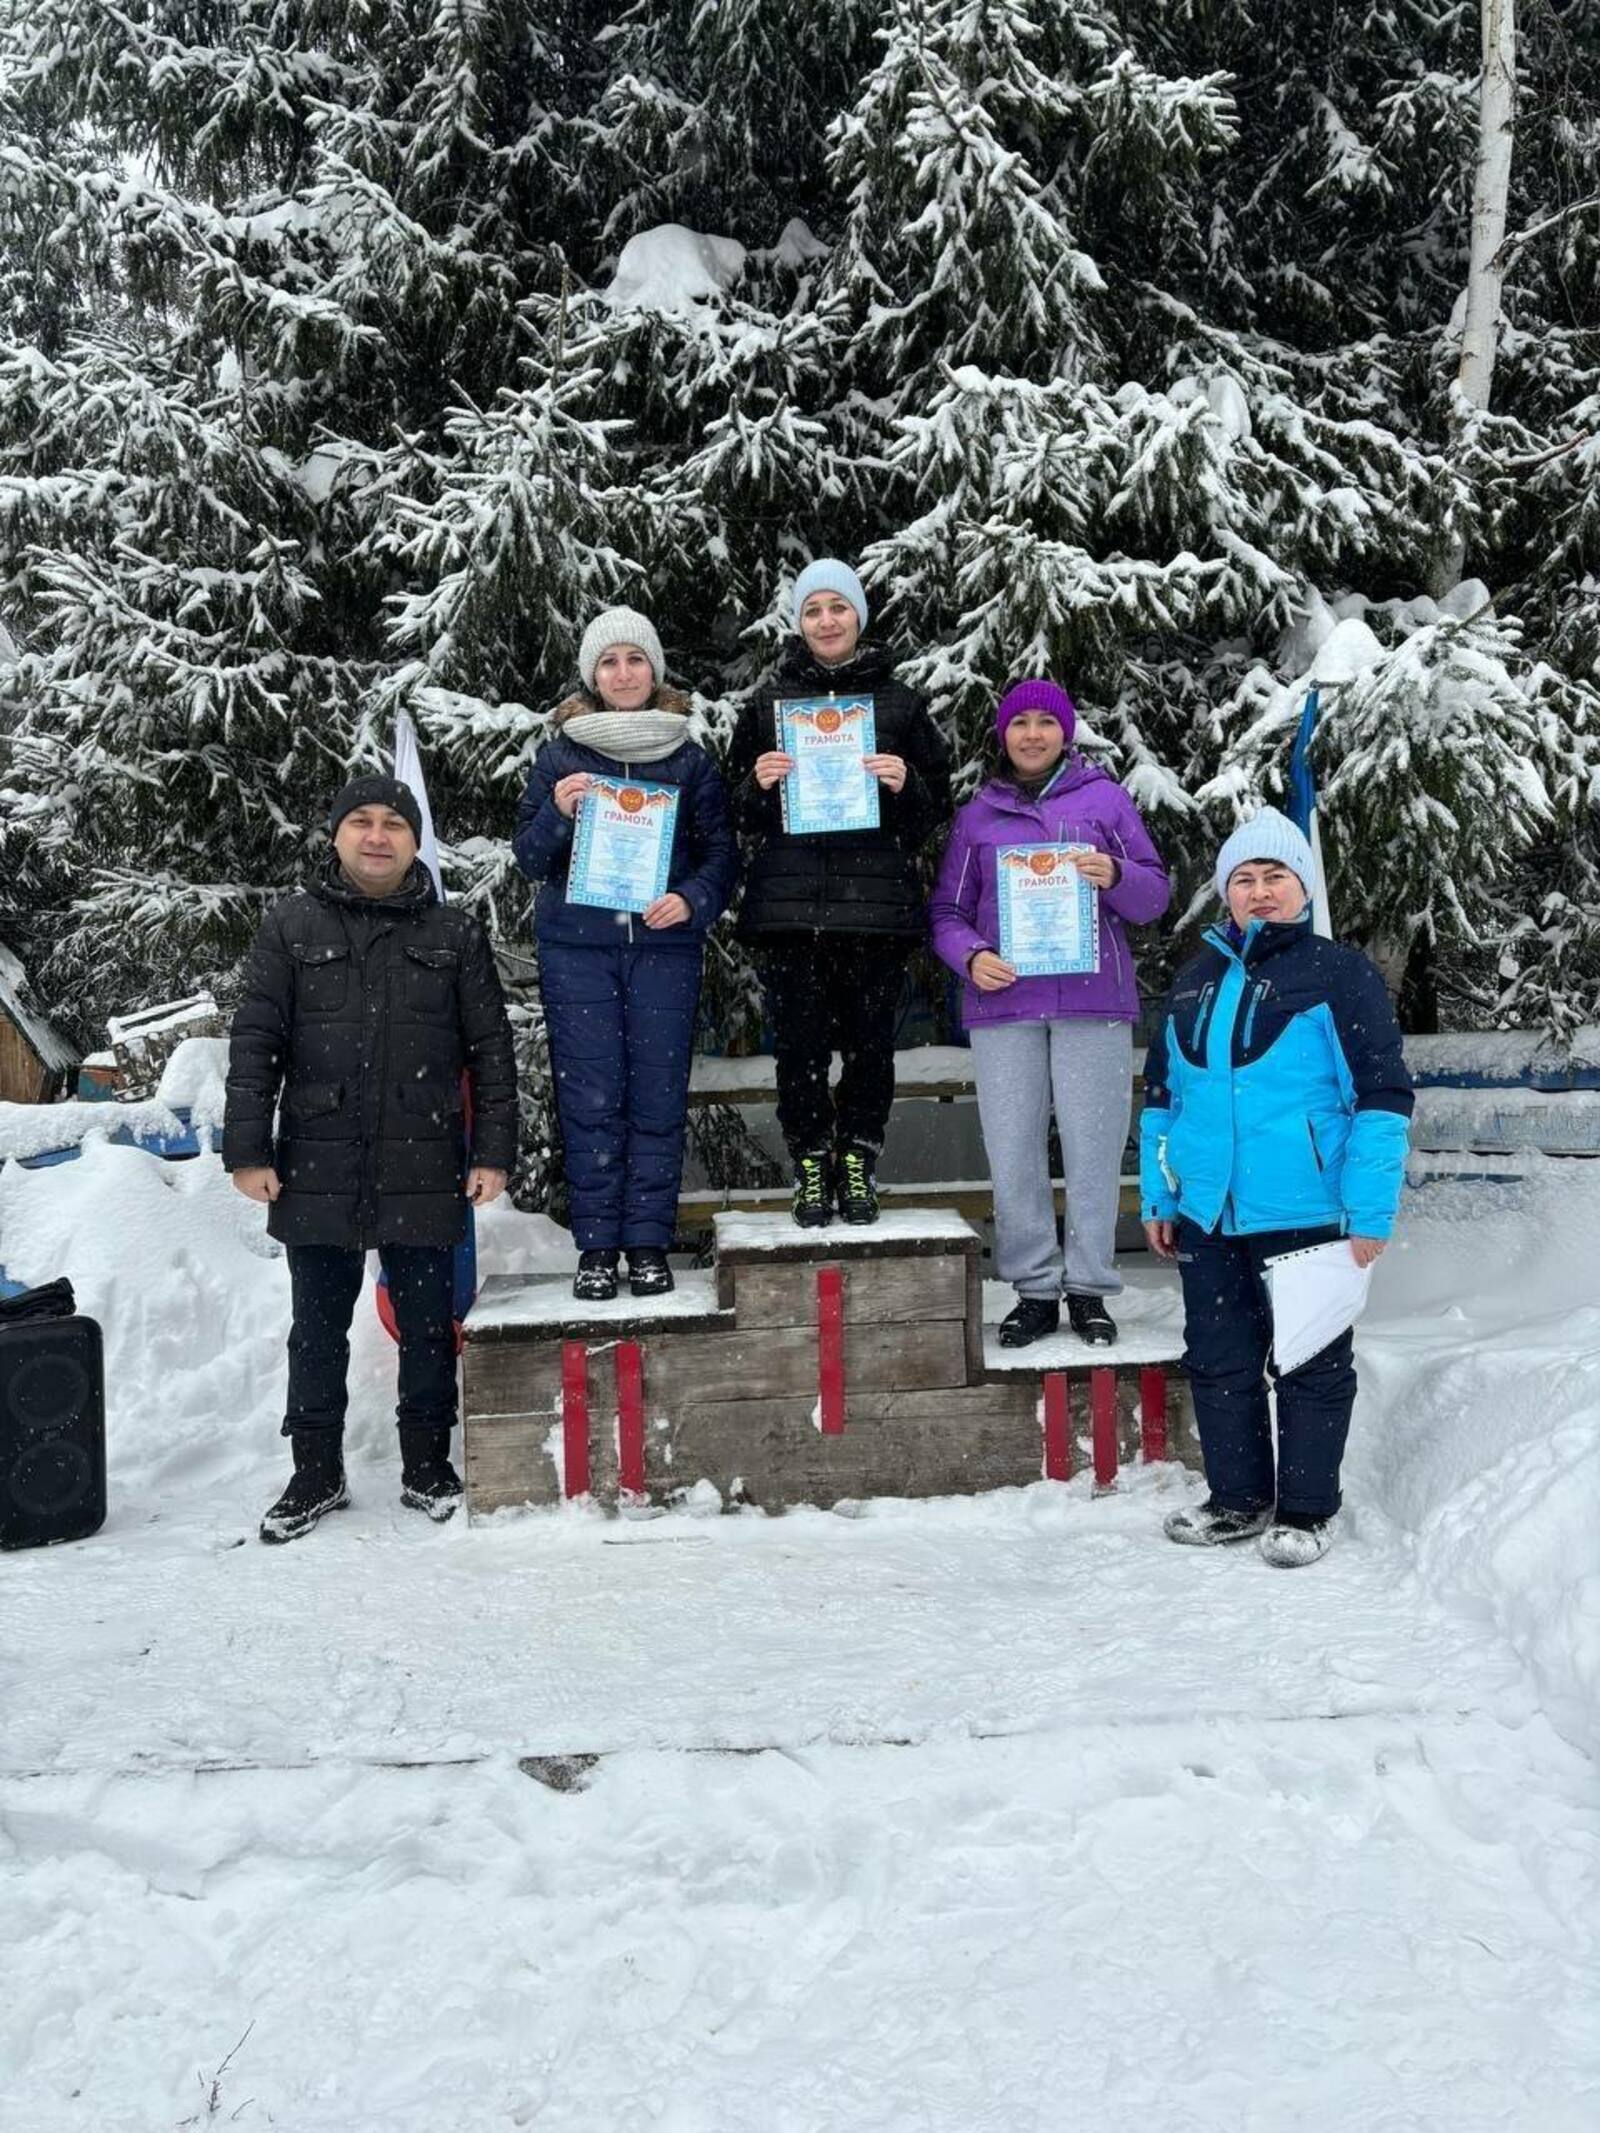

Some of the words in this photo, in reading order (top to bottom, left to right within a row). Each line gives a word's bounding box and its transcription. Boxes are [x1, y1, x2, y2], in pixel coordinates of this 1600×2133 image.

[804, 733, 855, 745] ГРАМОТА
[604, 810, 654, 827] ГРАМОТА
[1018, 876, 1069, 889] ГРАМОТА
